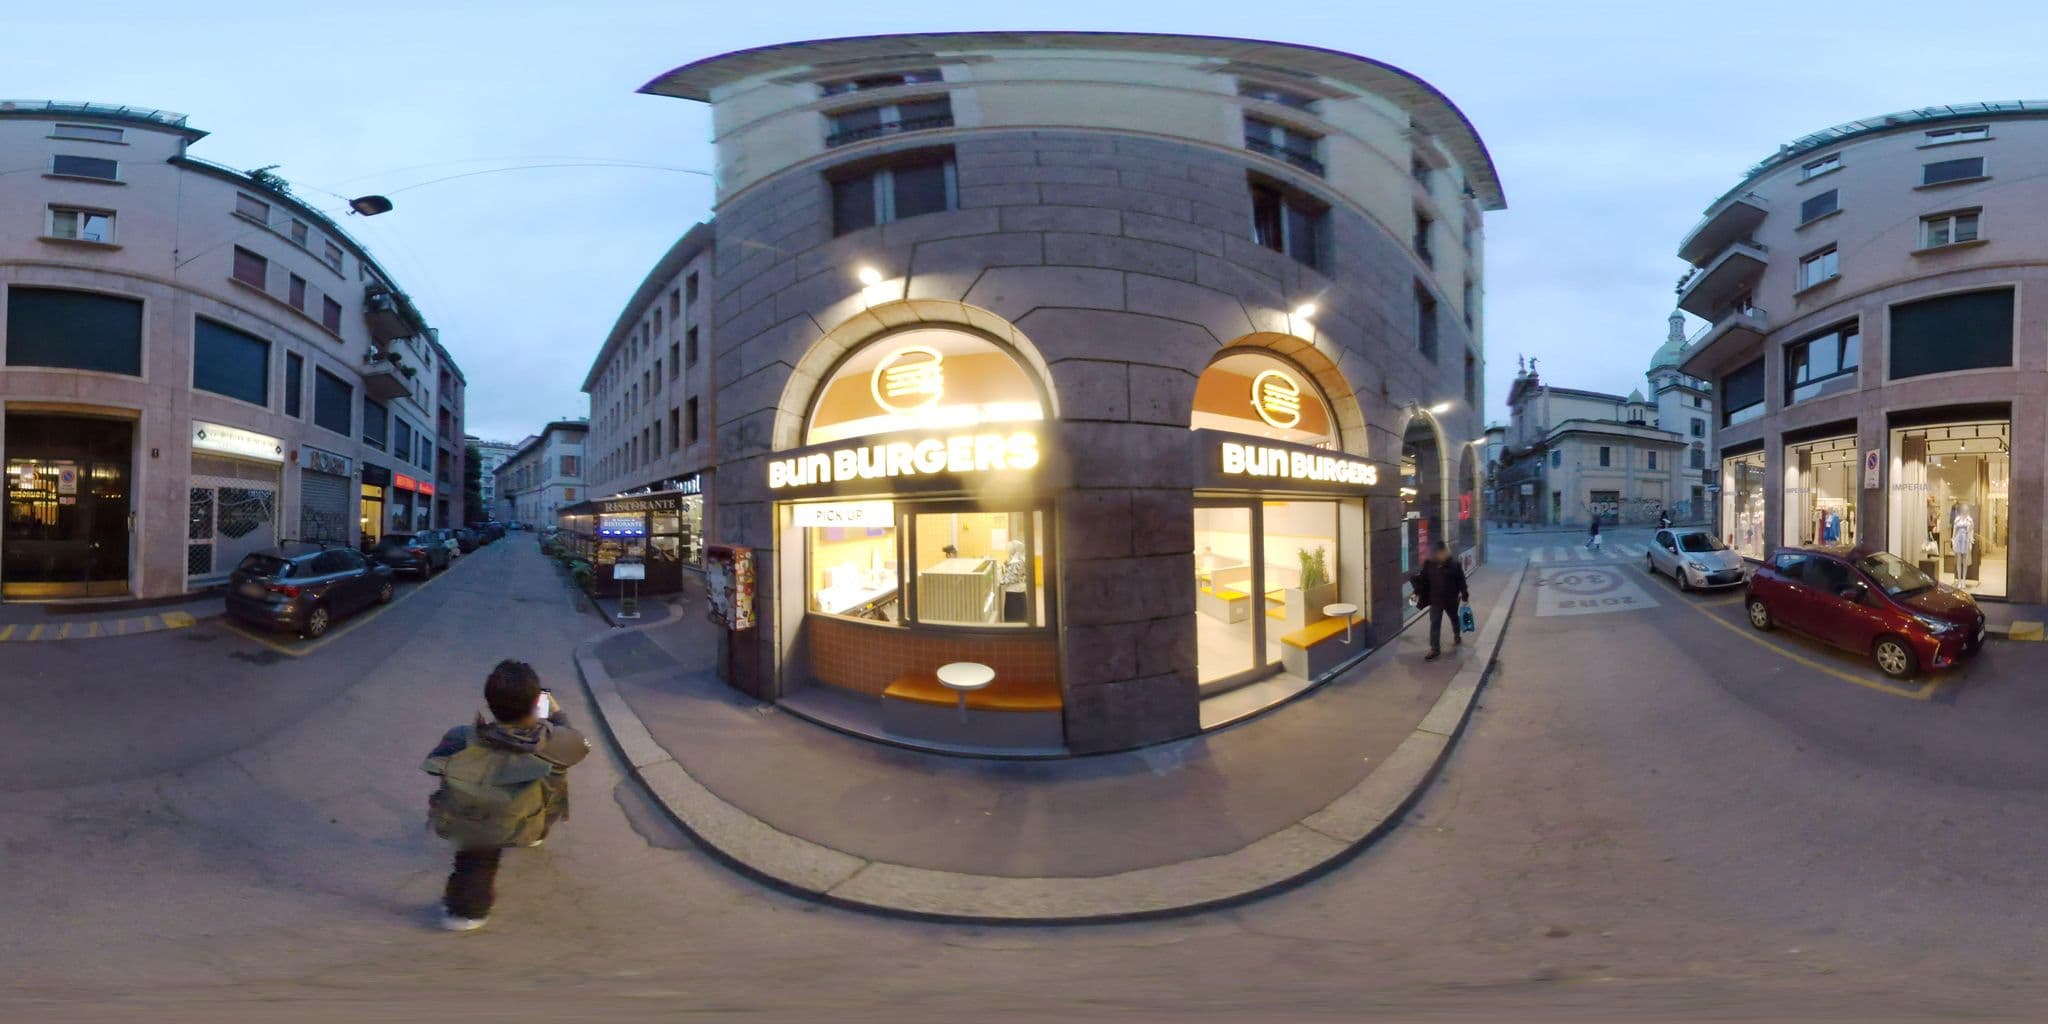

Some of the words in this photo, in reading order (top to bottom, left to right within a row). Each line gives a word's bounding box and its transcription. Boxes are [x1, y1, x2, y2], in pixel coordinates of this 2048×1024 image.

[833, 432, 1040, 481] BURGERS
[1291, 451, 1377, 486] BURGERS
[604, 499, 676, 512] RISTORANTE
[816, 510, 842, 522] PICK
[847, 509, 864, 521] UP
